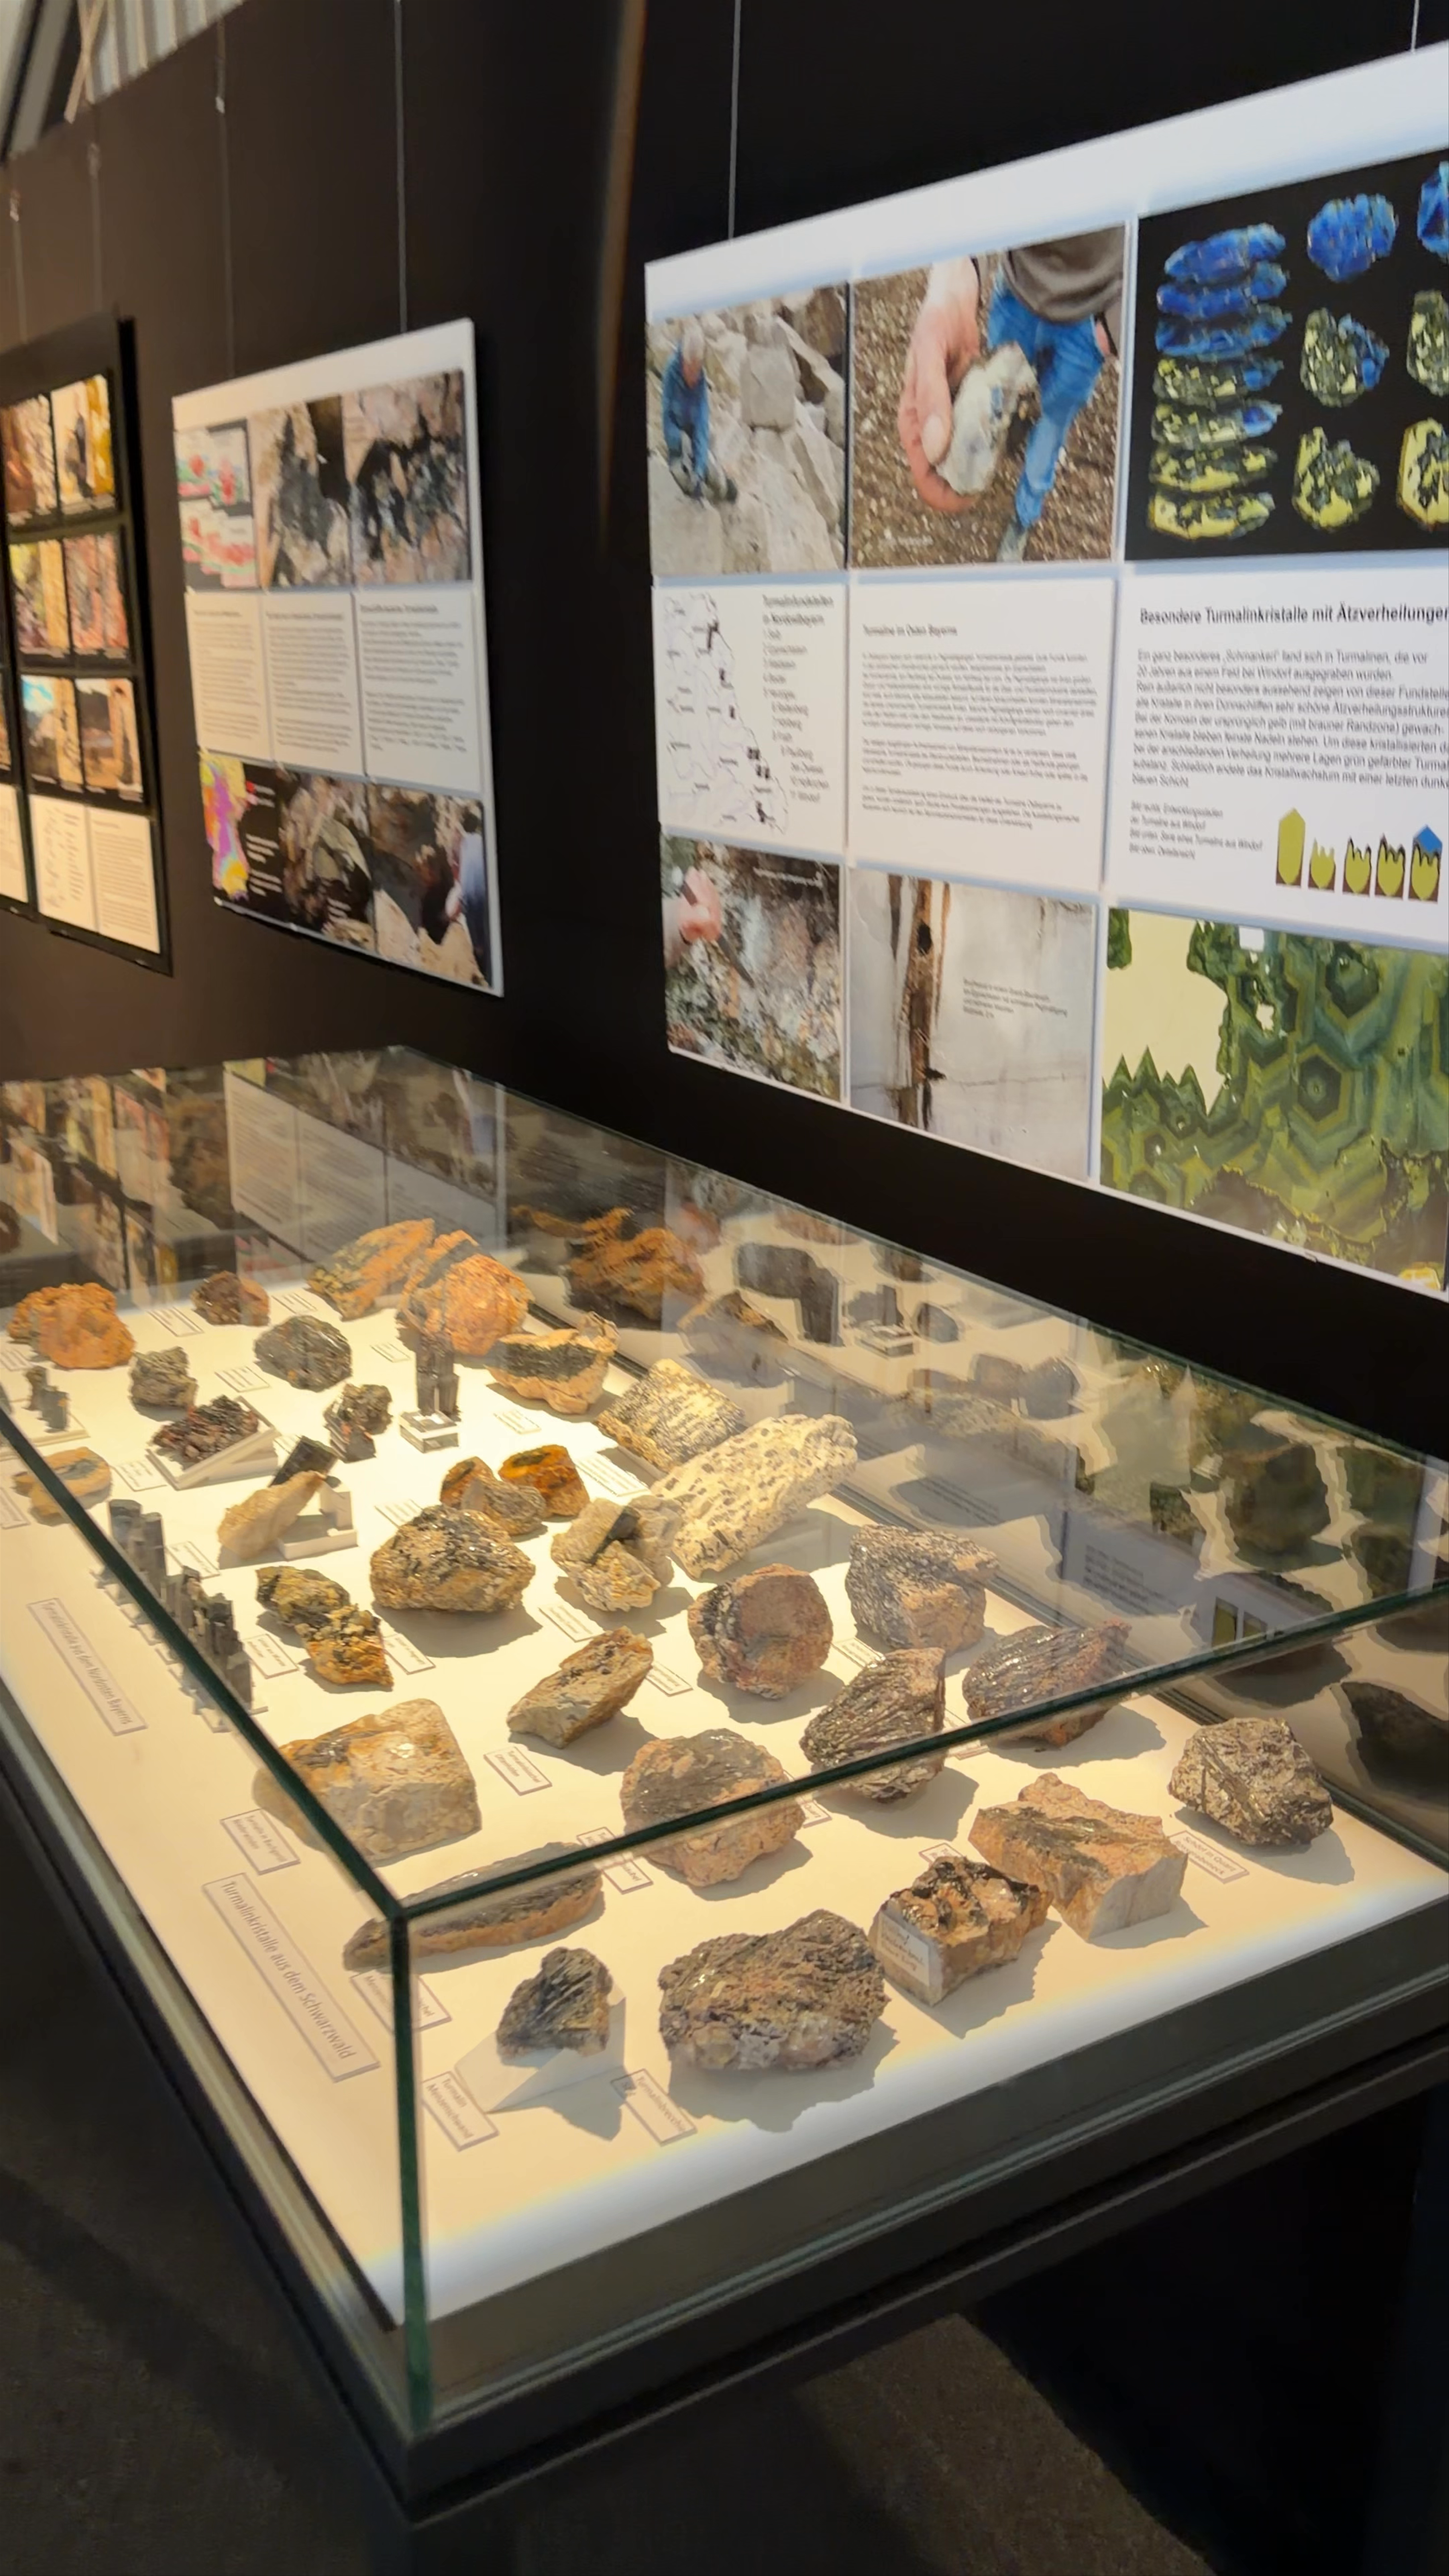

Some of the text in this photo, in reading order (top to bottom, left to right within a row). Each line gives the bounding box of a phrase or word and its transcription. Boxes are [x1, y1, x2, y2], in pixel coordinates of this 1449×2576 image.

[1140, 607, 1201, 624] Besondere
[1205, 604, 1308, 624] Turmalinkristalle
[1312, 604, 1333, 623] mit
[1304, 649, 1322, 663] sich
[1325, 650, 1333, 663] in
[1336, 649, 1391, 665] Turmalinen,
[1395, 650, 1409, 664] die
[1412, 652, 1427, 664] vor
[1294, 667, 1353, 683] ausgegraben
[1356, 667, 1393, 681] wurden.
[1313, 685, 1343, 700] zeigen
[1346, 686, 1363, 698] von
[1366, 685, 1395, 699] dieser
[1399, 684, 1448, 700] Fundstelle
[1308, 718, 1343, 732] brauner
[1346, 718, 1399, 735] Randzone)
[1323, 735, 1340, 748] Um
[1342, 737, 1367, 750] diese
[1313, 751, 1341, 766] Lagen
[1342, 771, 1356, 784] mit
[1359, 772, 1383, 785] einer
[1386, 772, 1418, 787] letzten
[222, 1881, 357, 2060] Turmalinkristalle aus dem Schwarzwald
